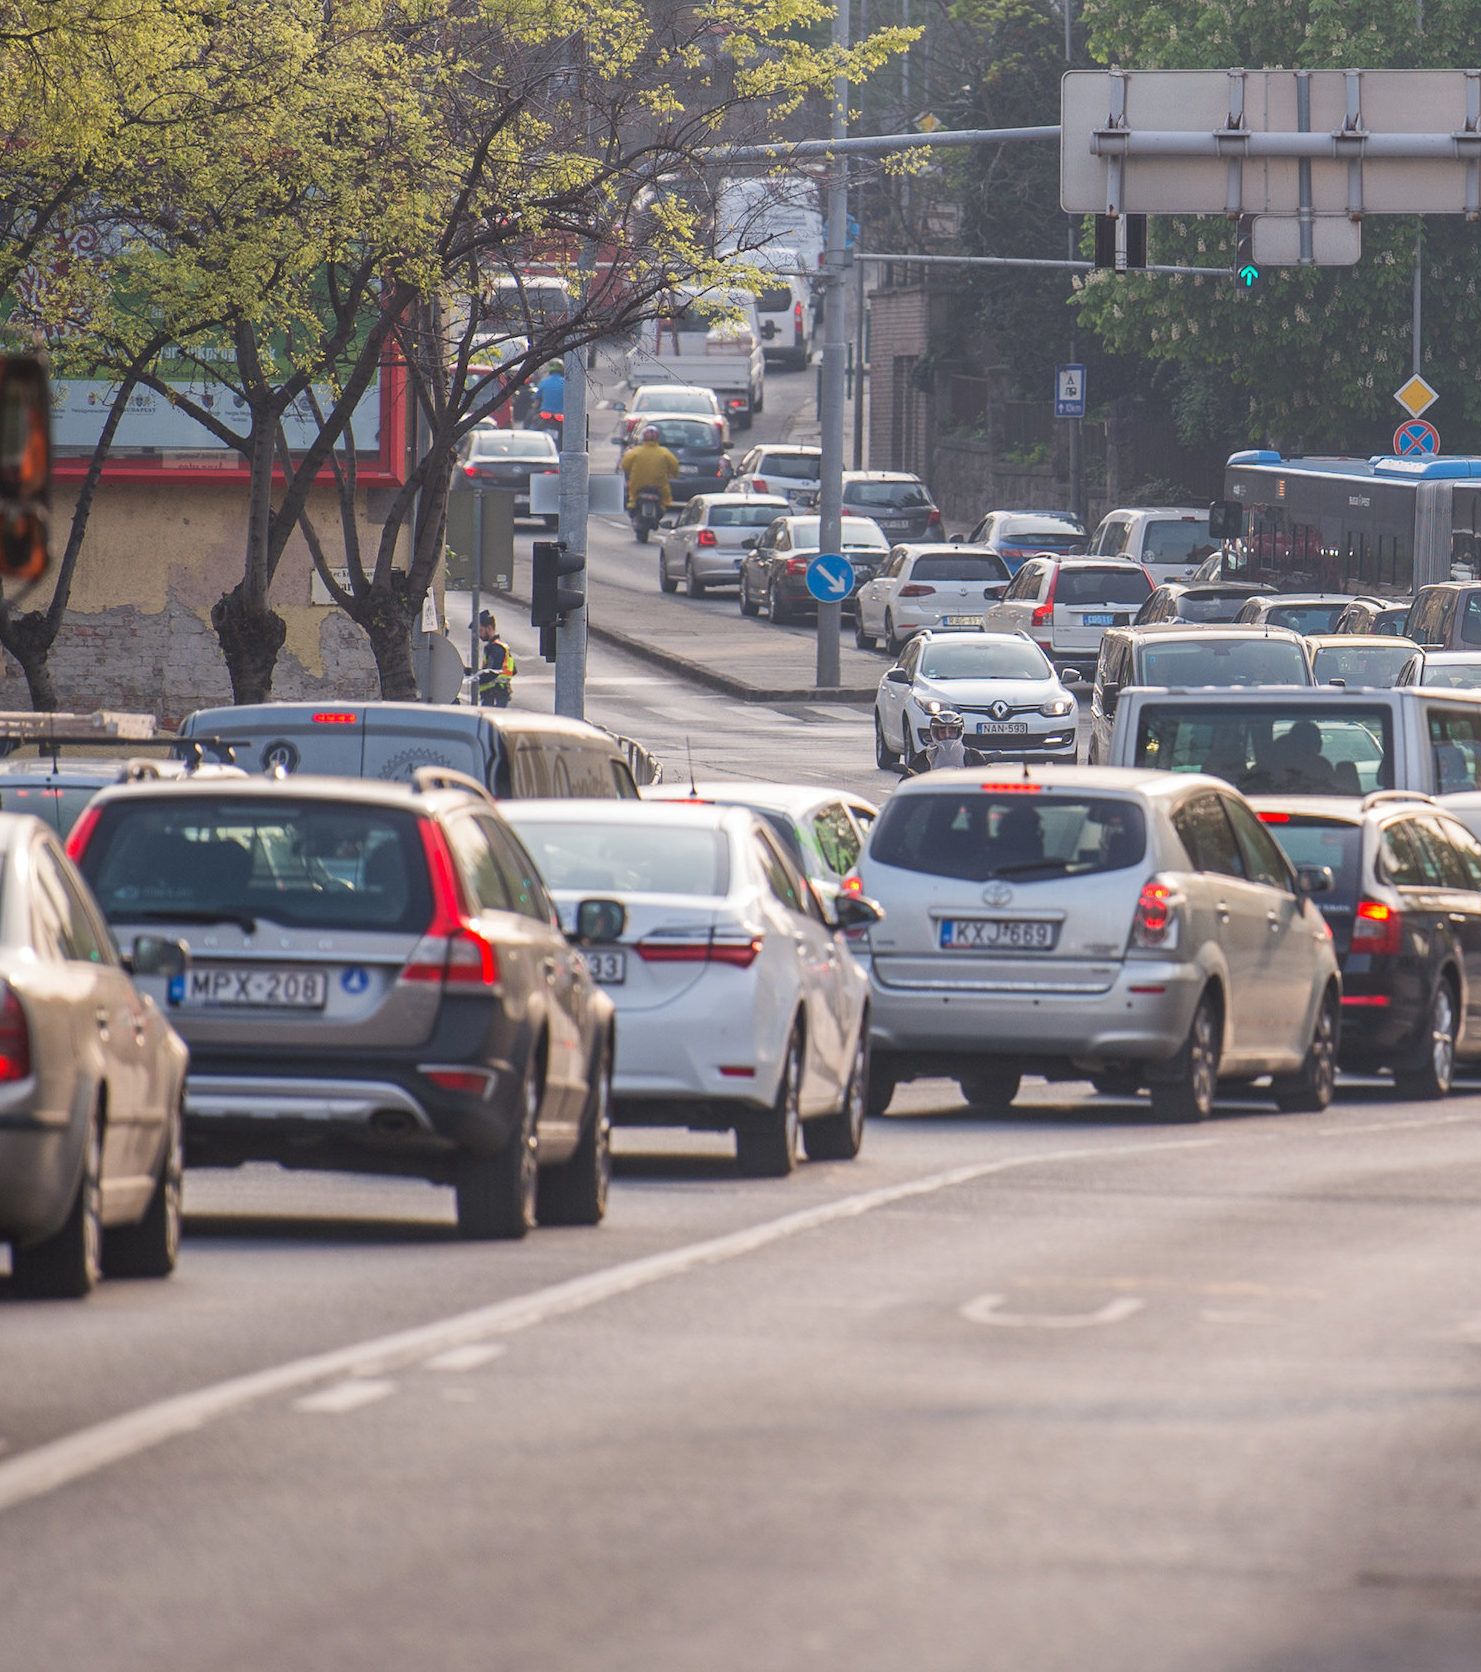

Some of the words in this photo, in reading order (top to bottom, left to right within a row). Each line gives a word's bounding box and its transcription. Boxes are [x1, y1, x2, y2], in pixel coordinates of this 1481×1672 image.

[983, 723, 1026, 734] NAN-593
[589, 953, 618, 978] 33
[191, 971, 318, 1001] MPX-208
